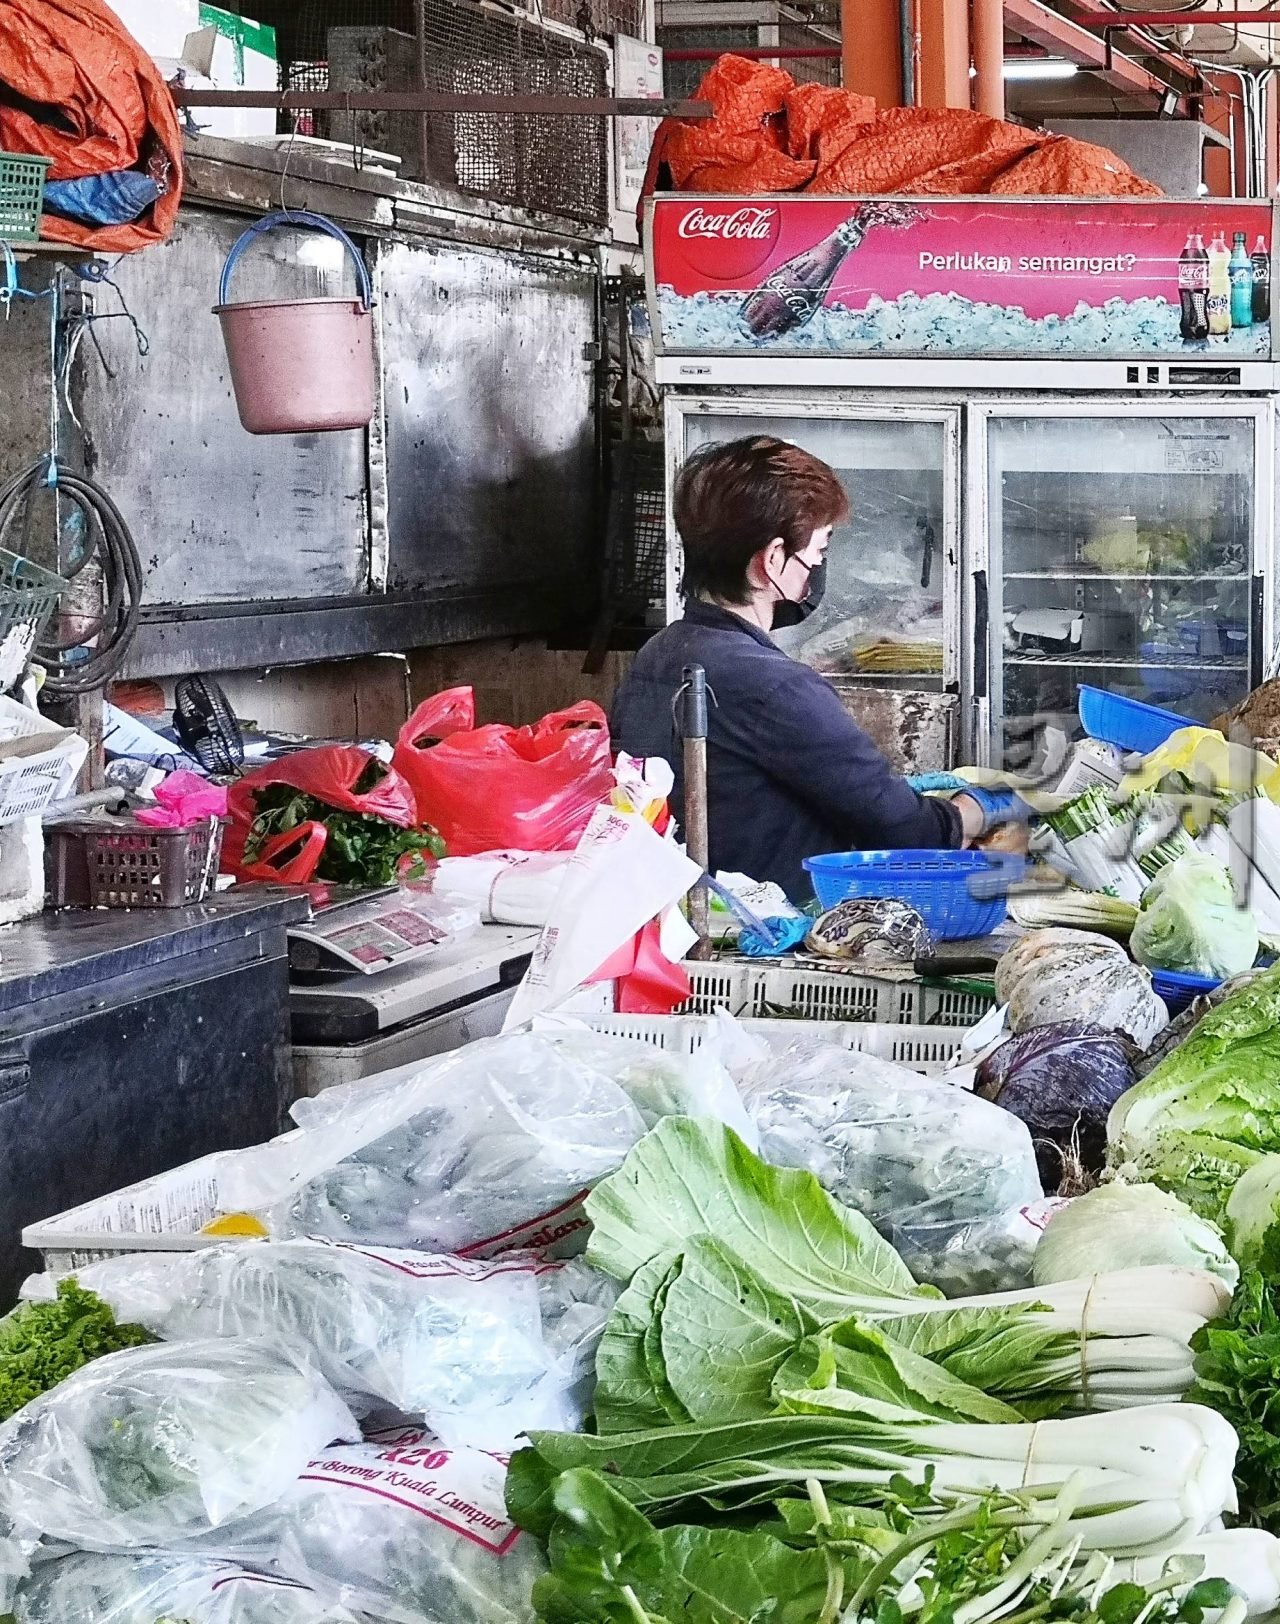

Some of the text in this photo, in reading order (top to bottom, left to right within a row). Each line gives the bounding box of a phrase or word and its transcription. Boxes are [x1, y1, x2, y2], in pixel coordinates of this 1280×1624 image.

[678, 207, 777, 239] Coca-Cola
[919, 252, 1137, 274] Perlukan semangat?
[321, 1460, 507, 1533] Borong Kuala Lumpur
